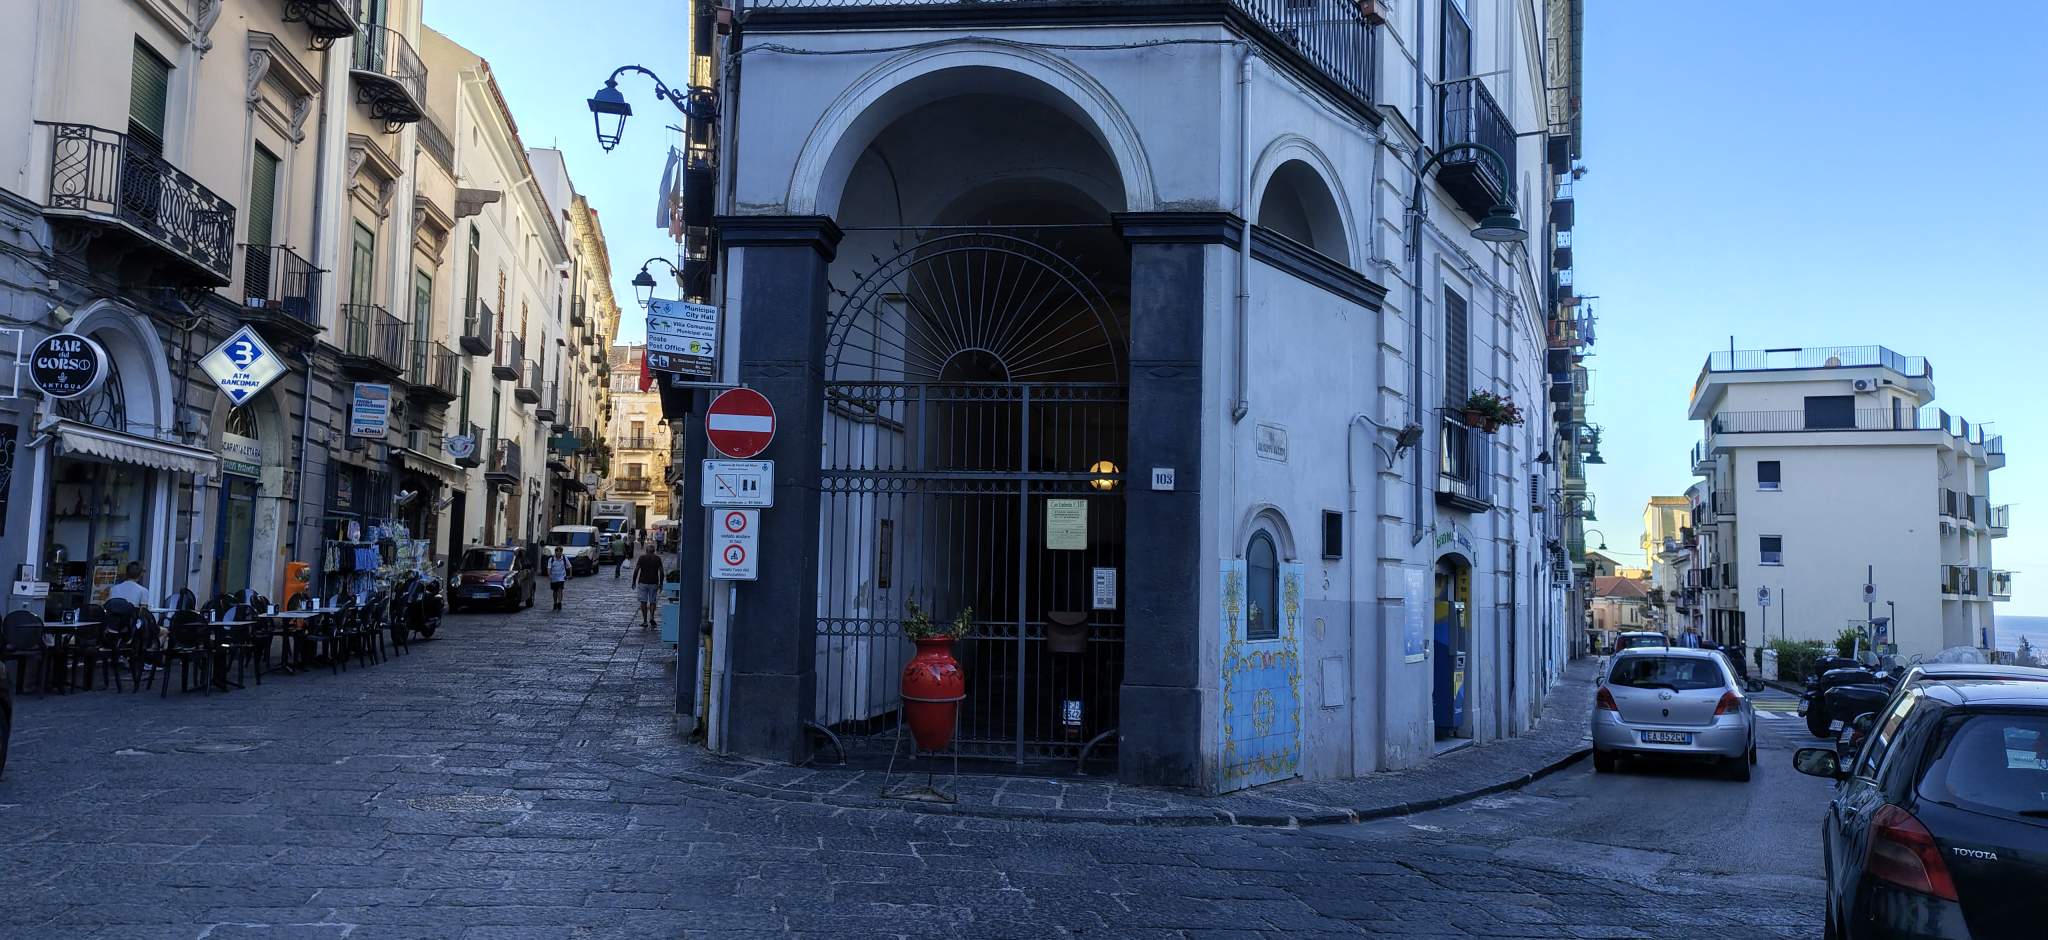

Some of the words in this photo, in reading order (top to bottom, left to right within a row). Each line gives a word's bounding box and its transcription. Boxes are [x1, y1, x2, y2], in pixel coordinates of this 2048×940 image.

[685, 305, 716, 314] Municipio
[687, 323, 714, 331] Comunale
[50, 339, 81, 352] BAR
[221, 379, 260, 387] BANCOMAT
[1156, 474, 1172, 484] 103
[1952, 847, 1998, 860] TOYOTA
